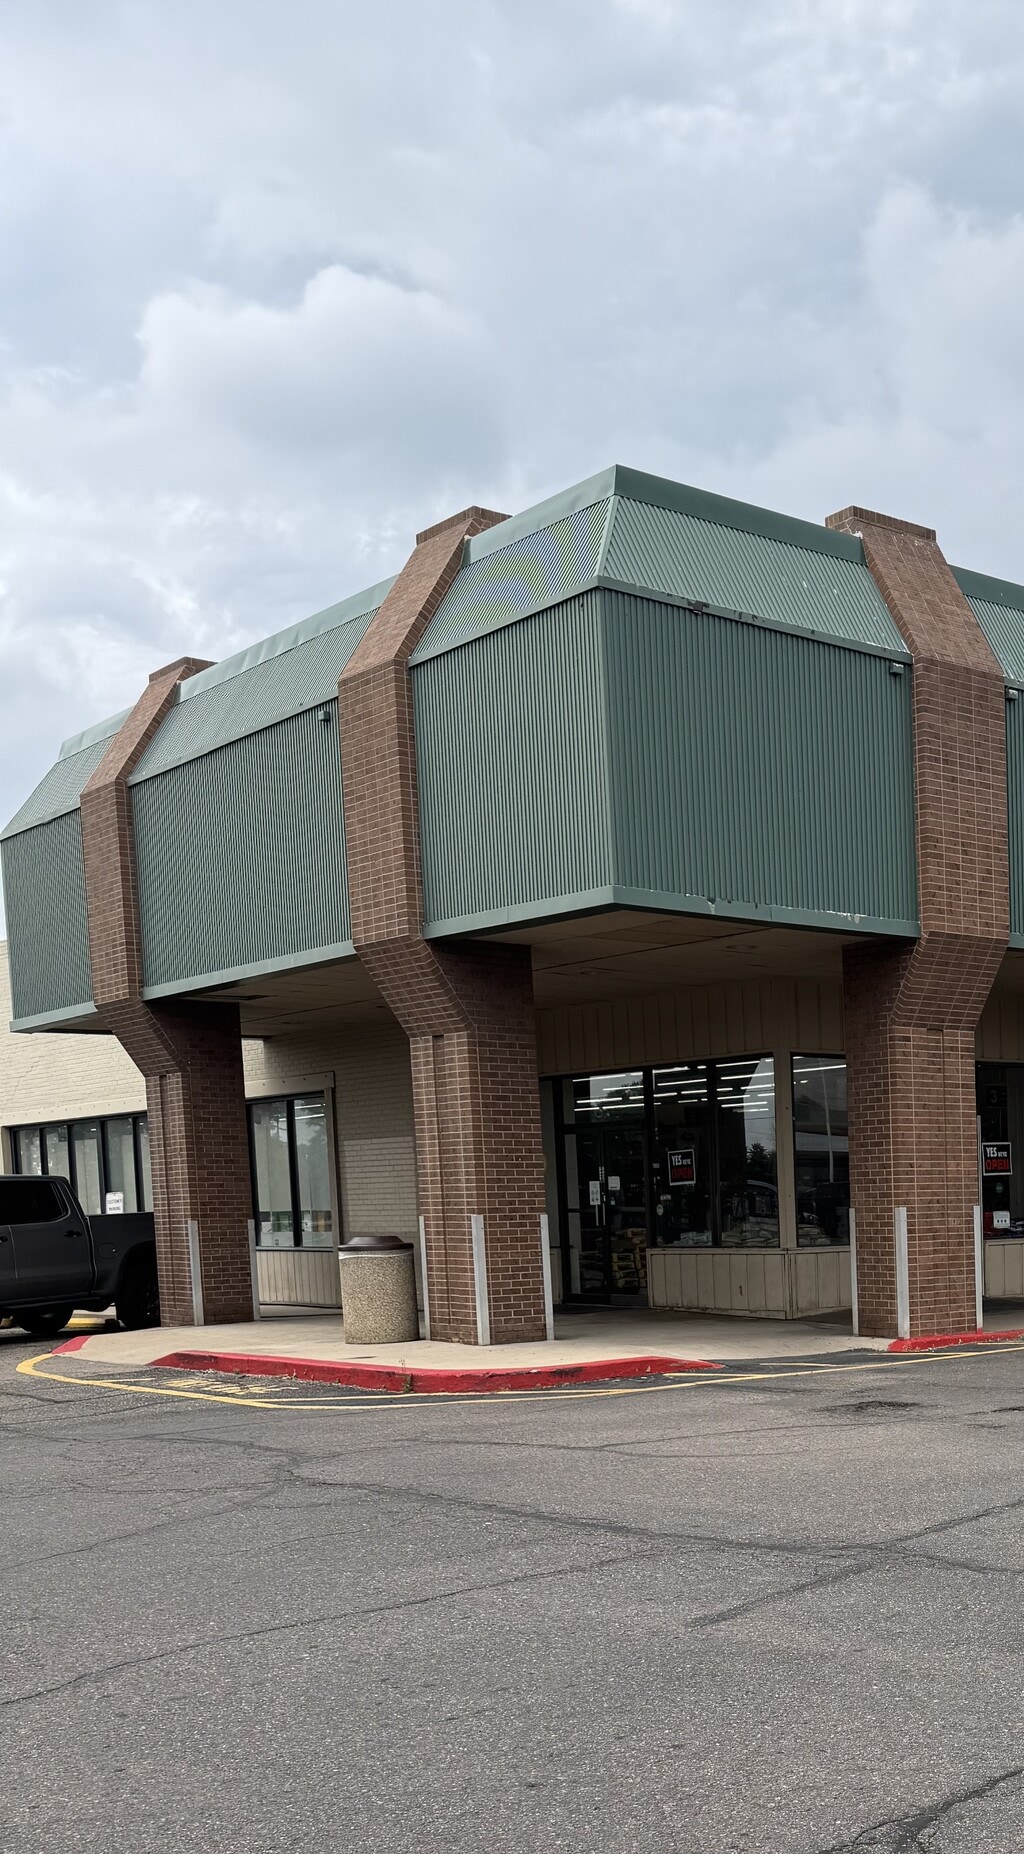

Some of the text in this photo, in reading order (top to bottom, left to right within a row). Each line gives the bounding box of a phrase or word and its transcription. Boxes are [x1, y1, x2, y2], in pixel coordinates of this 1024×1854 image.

[985, 1146, 997, 1158] YES
[671, 1155, 682, 1166] YES
[985, 1158, 1009, 1171] OPEN
[672, 1167, 693, 1179] OPEN
